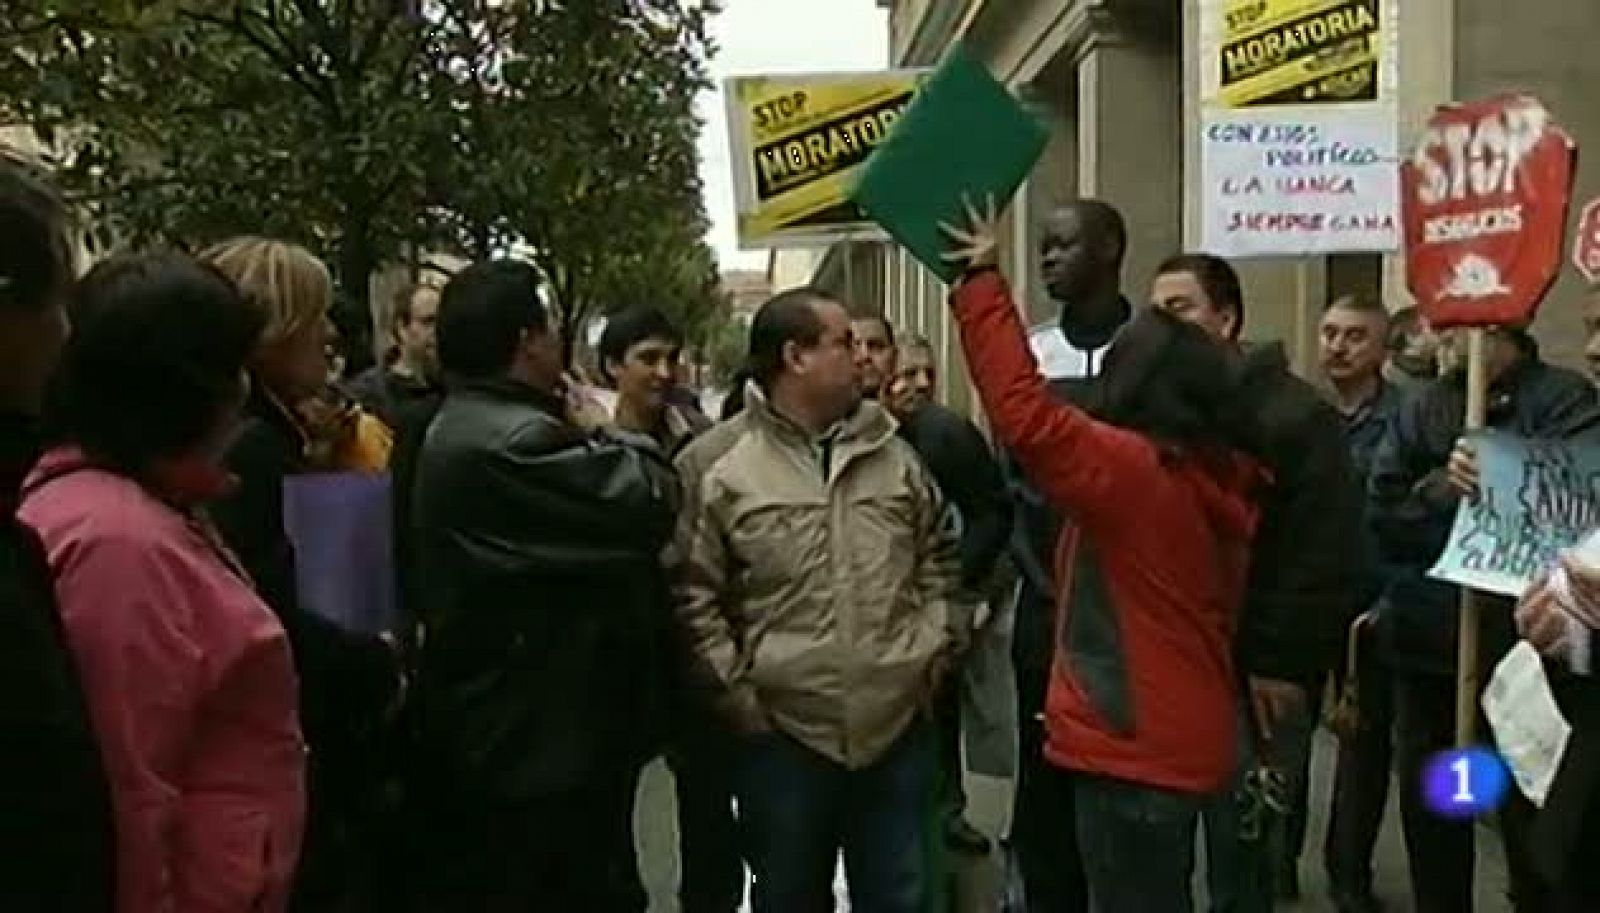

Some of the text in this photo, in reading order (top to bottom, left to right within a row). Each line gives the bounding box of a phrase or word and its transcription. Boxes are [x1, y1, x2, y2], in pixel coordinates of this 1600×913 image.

[1225, 4, 1376, 77] MORATORIA
[752, 90, 807, 128] STOP
[1415, 96, 1549, 204] STOP
